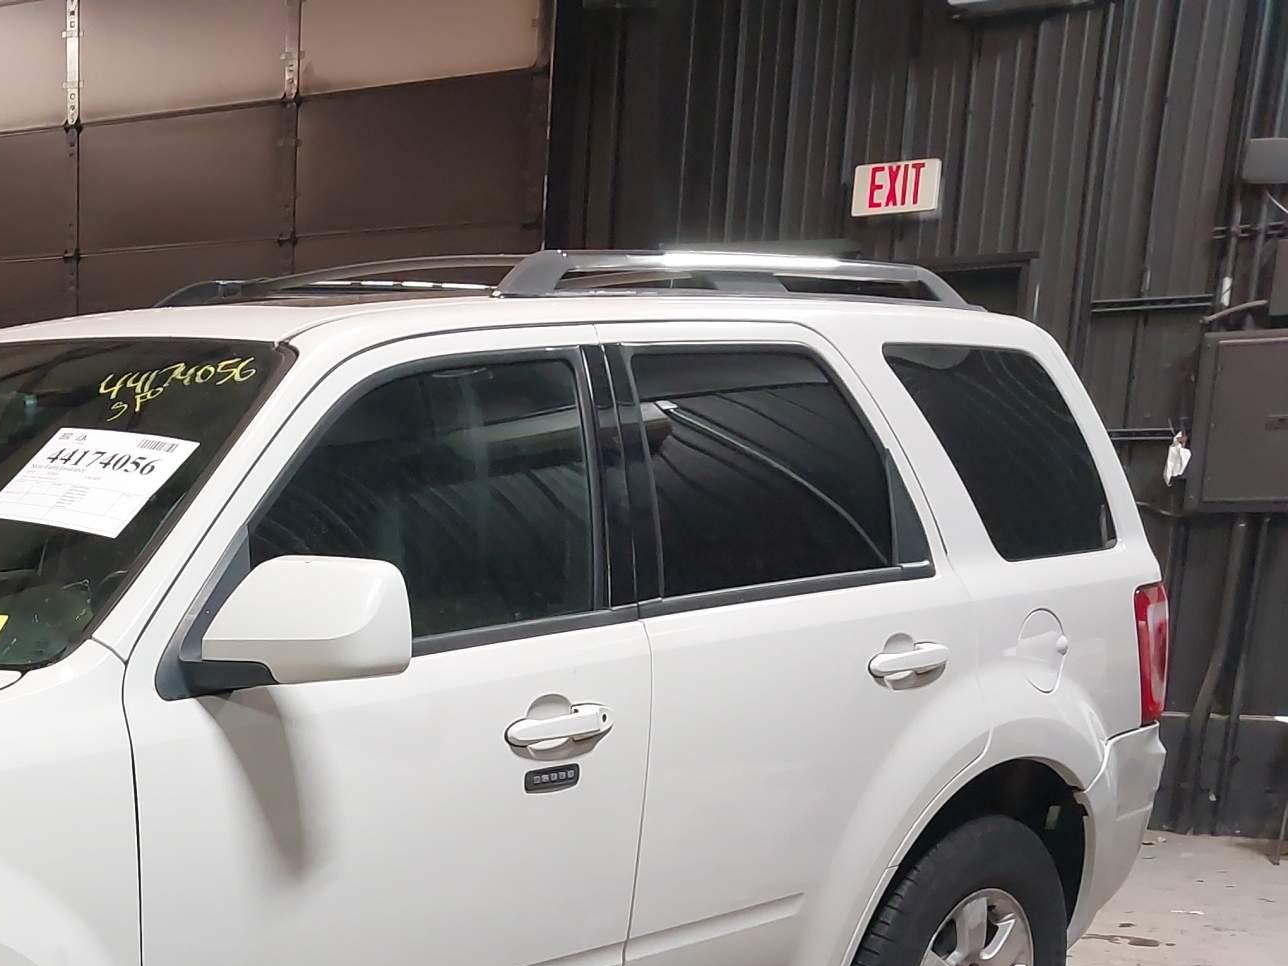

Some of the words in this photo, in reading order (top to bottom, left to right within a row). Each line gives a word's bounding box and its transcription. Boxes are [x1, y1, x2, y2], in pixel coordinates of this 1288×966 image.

[868, 162, 926, 209] EXIT
[99, 357, 256, 399] 44174056
[47, 447, 160, 476] 44174056
